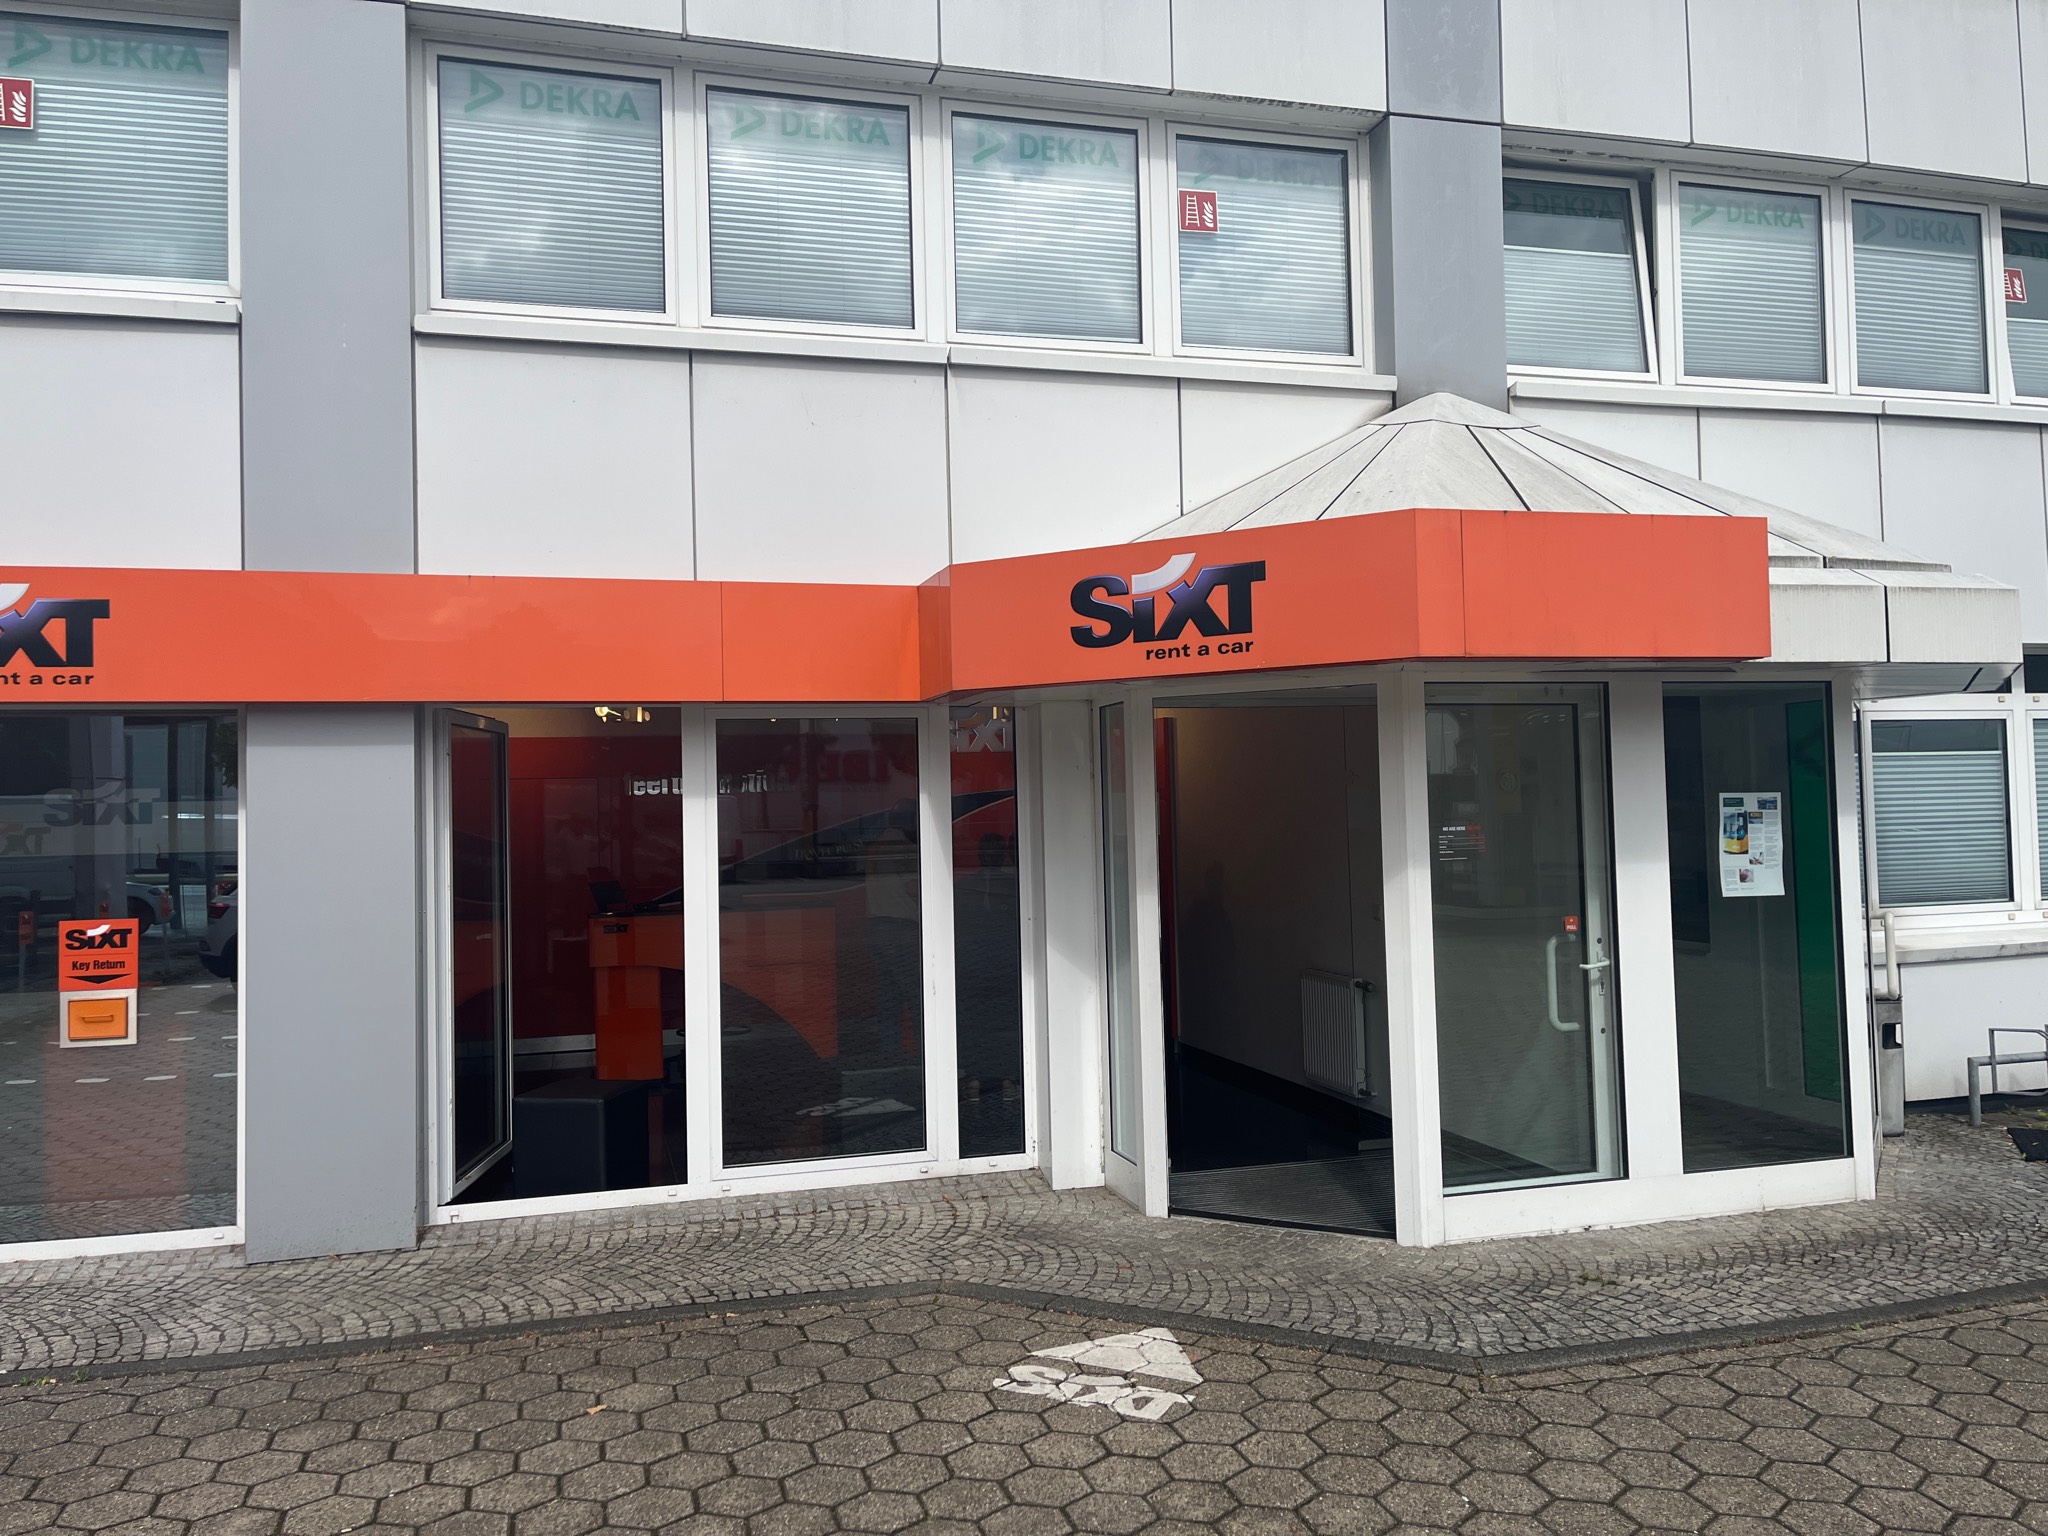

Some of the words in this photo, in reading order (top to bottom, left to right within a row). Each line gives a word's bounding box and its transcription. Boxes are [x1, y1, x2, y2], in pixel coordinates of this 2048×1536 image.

[70, 36, 205, 76] DEKRA
[519, 80, 641, 122] DEKRA
[780, 109, 891, 147] DEKRA
[1018, 133, 1121, 169] DEKRA
[1531, 192, 1614, 219] DEKRA
[1726, 198, 1805, 230] DEKRA
[1895, 215, 1966, 246] DEKRA
[0, 583, 111, 667] XT
[1146, 644, 1191, 660] rent
[1197, 644, 1210, 656] a
[1217, 640, 1254, 655] car
[0, 672, 21, 685] nt
[30, 674, 43, 685] a
[52, 674, 95, 685] car
[72, 960, 91, 972] Key
[93, 960, 126, 970] Return
